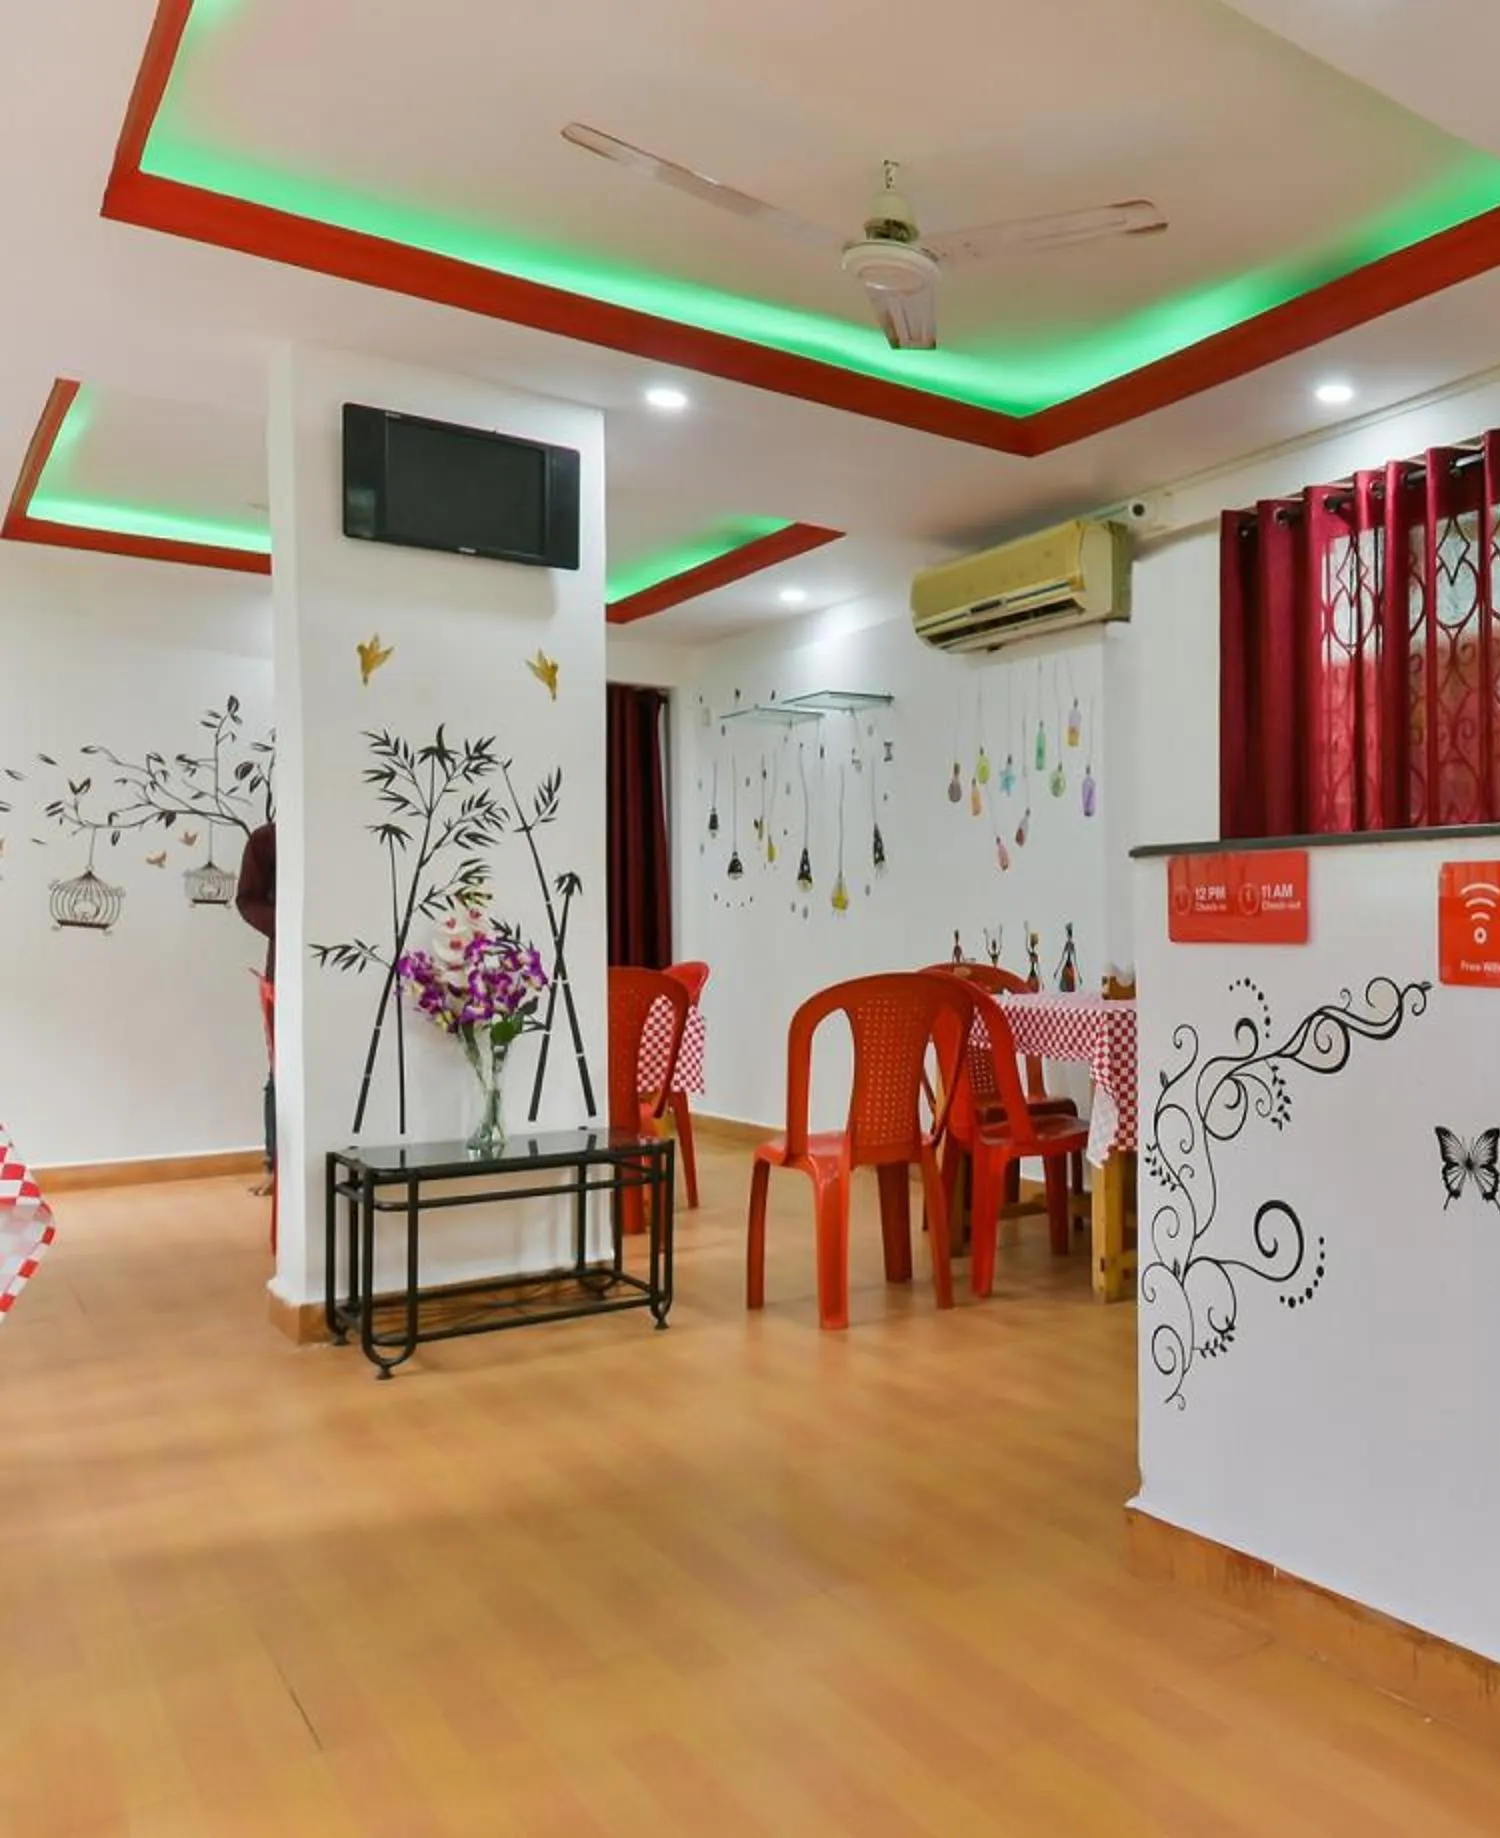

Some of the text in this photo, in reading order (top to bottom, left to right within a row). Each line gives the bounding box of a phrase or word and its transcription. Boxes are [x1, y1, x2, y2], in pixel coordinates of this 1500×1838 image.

[1195, 885, 1226, 900] 12 PM
[1273, 883, 1293, 897] AM
[1461, 960, 1482, 972] Free
